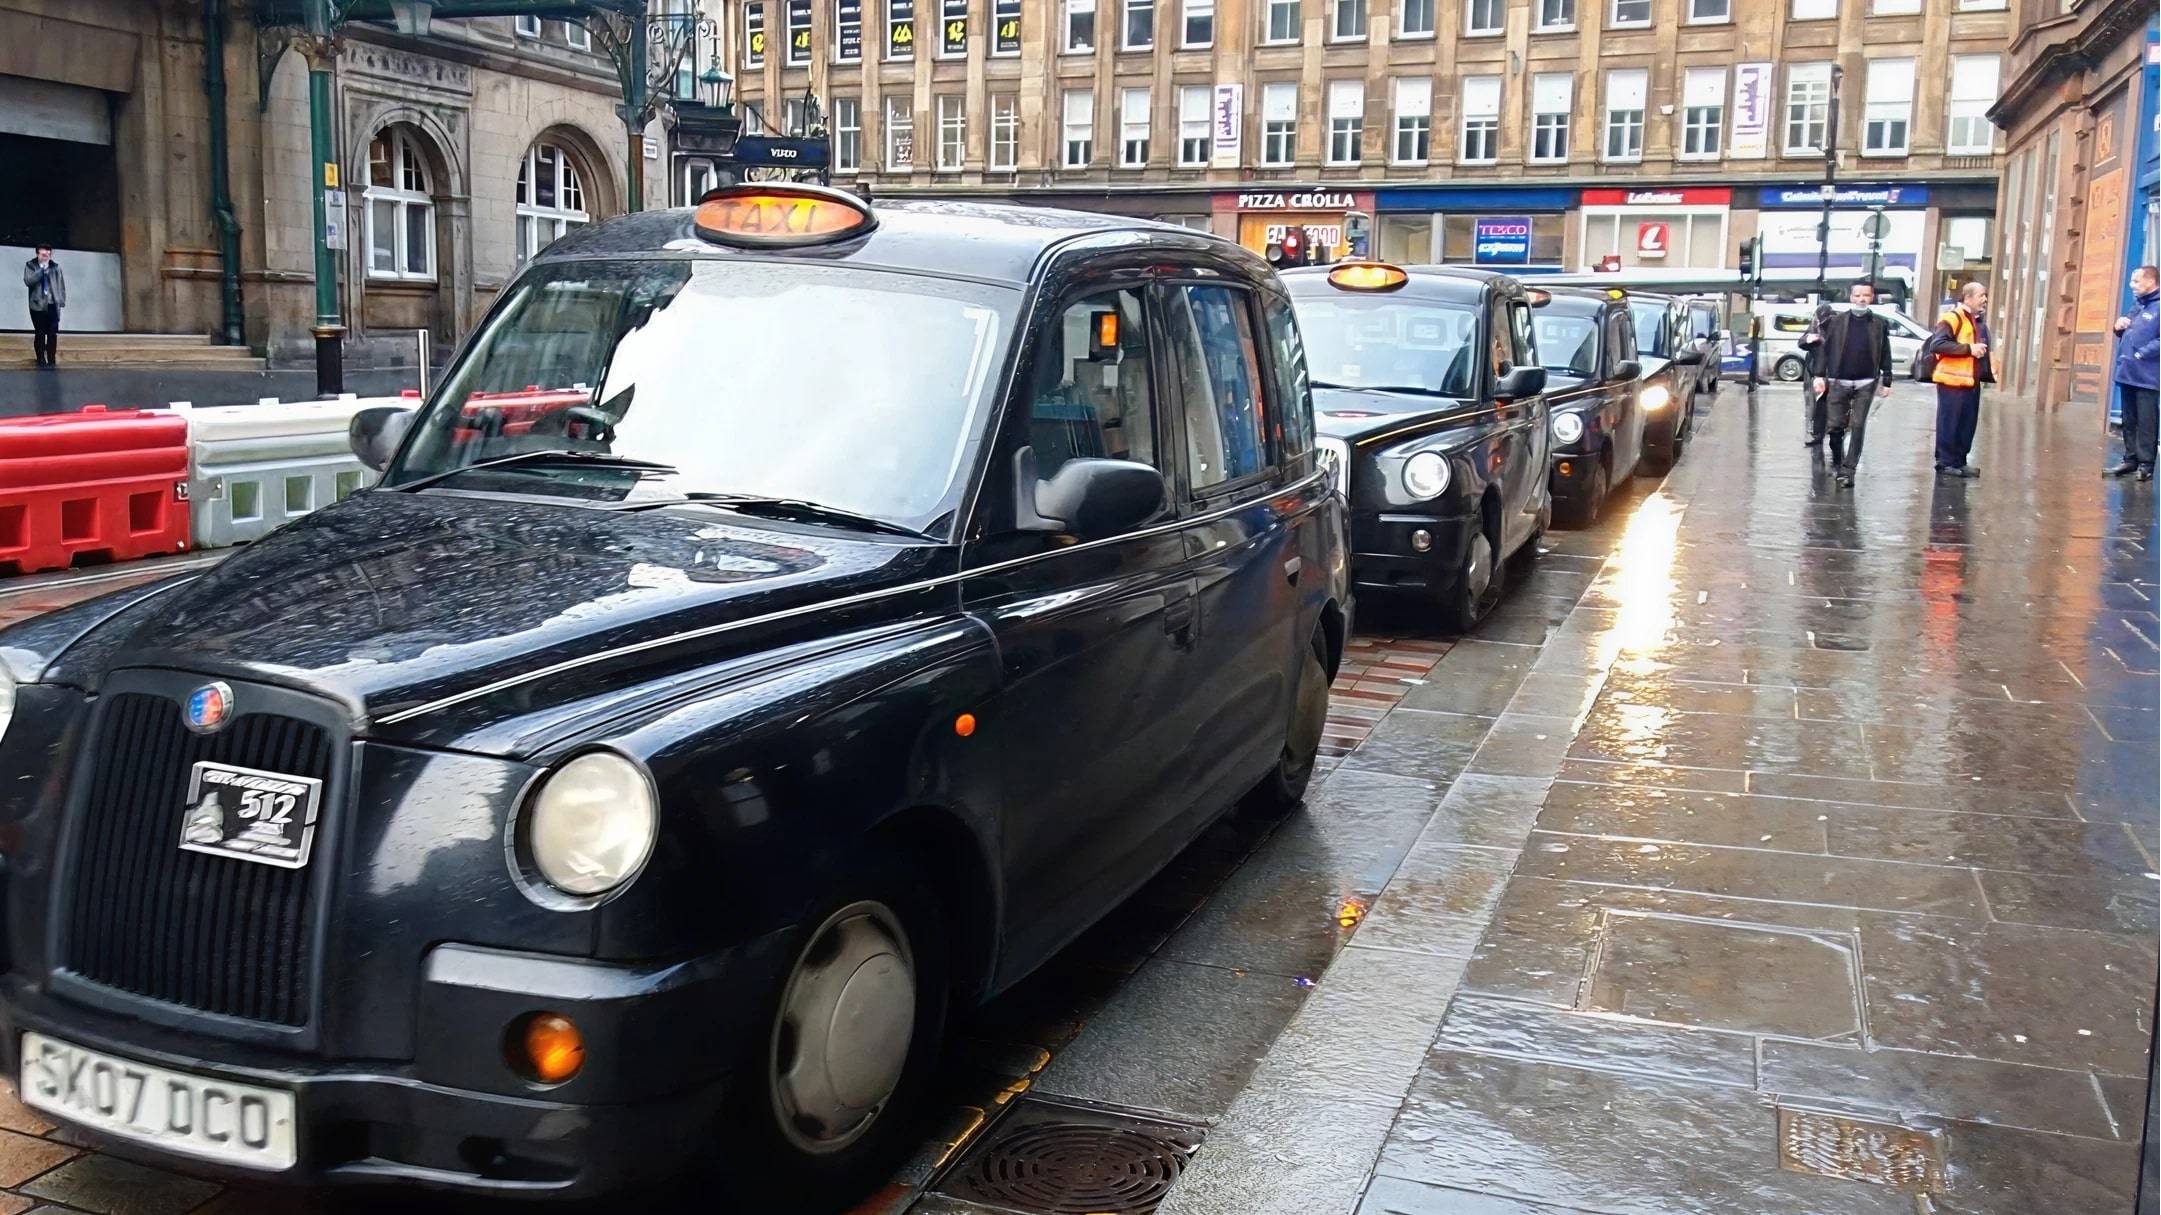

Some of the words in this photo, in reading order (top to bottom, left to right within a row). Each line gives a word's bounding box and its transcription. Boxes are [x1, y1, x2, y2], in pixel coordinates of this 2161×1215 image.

[716, 201, 818, 233] TAXI
[1238, 194, 1286, 208] PIZZA
[1479, 225, 1527, 235] TESCO
[237, 789, 296, 824] 512
[37, 1042, 146, 1124] SK07
[167, 1079, 270, 1149] DCO
